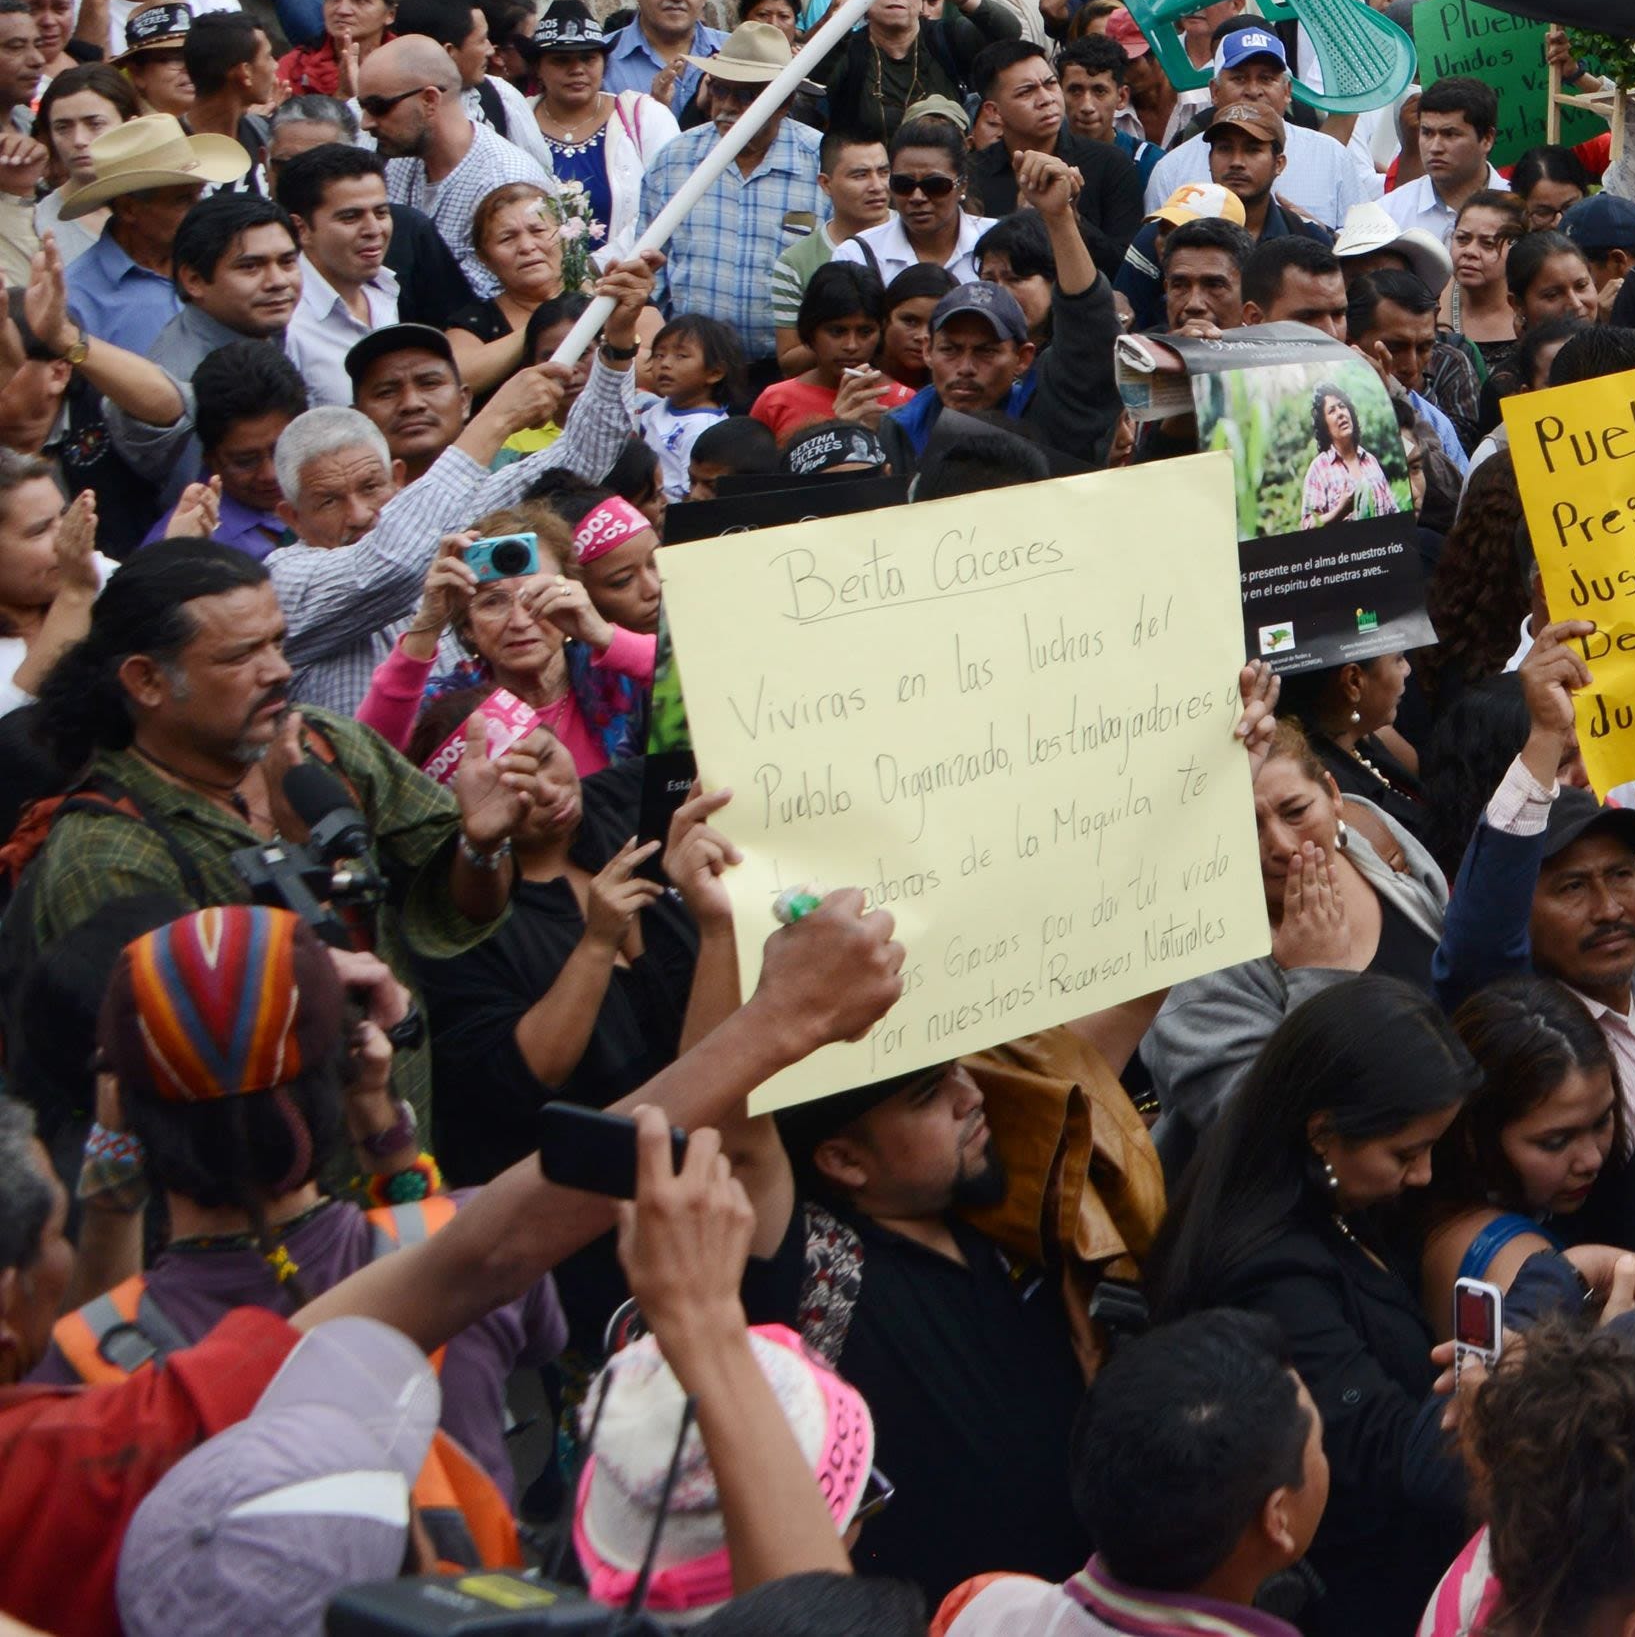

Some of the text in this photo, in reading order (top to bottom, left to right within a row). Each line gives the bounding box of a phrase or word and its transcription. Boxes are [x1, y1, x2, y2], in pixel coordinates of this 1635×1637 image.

[1242, 34, 1268, 48] CAT
[1434, 47, 1513, 77] Unidos
[790, 432, 835, 461] BERTHA
[791, 440, 842, 472] CACERES
[769, 526, 1065, 621] Berta Cáceres
[1250, 542, 1404, 582] presente en el alma de nuestros ríos
[727, 594, 1173, 740] Viviras en las luchas del
[753, 761, 853, 830] Pueblo
[960, 755, 1208, 877] de la Maquila te
[1040, 912, 1075, 989] por
[1090, 899, 1121, 928] dar
[1183, 835, 1229, 891] vida
[928, 980, 1036, 1044] nuestros
[1047, 952, 1131, 1000] Recursos
[1144, 913, 1226, 969] Naturales
